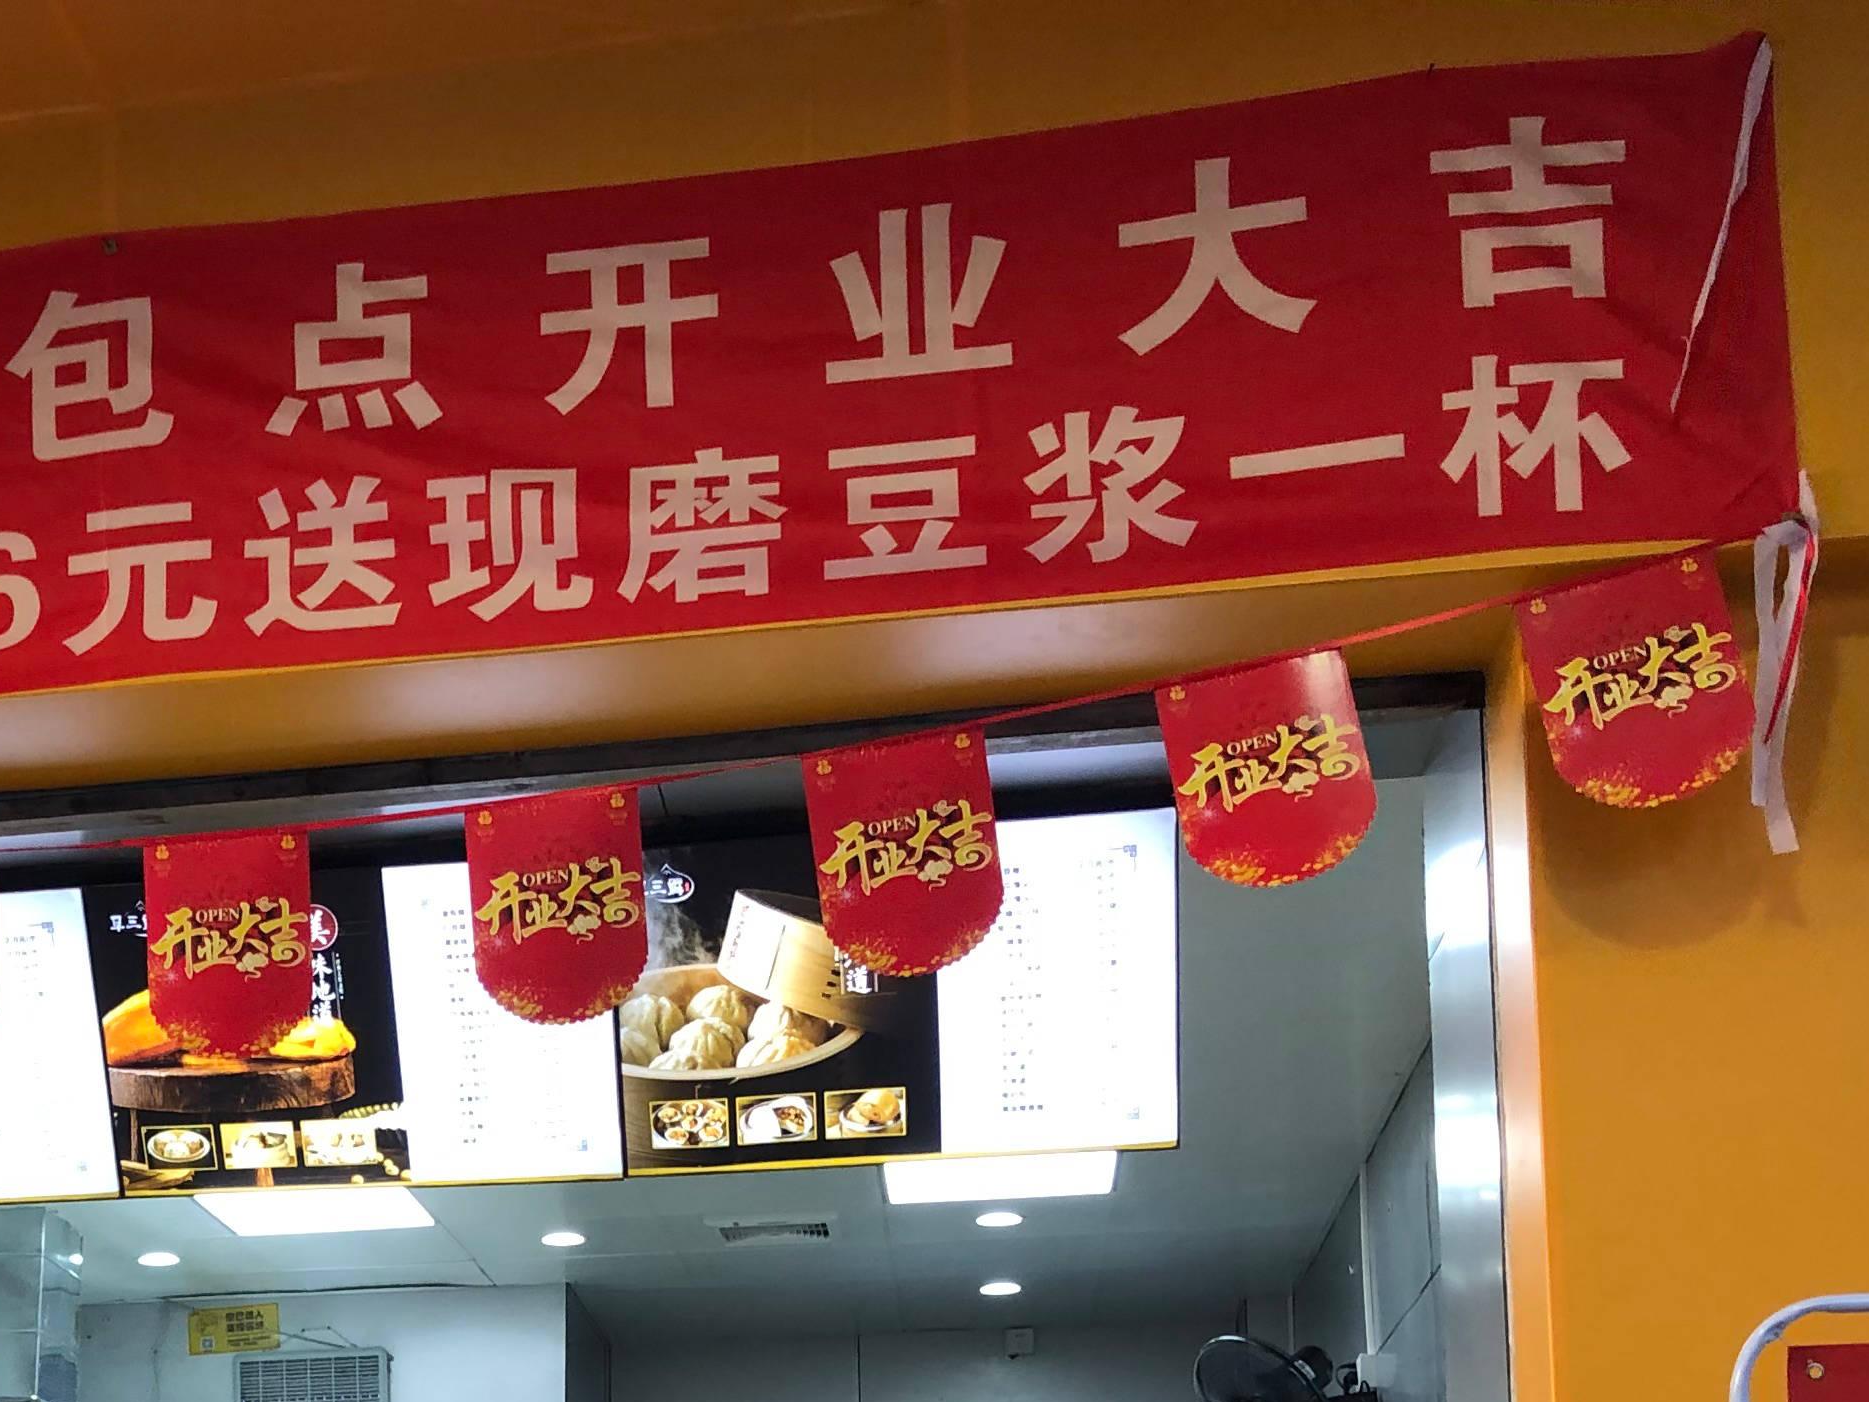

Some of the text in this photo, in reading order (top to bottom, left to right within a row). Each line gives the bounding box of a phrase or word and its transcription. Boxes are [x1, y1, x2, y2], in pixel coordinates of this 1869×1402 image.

[1544, 622, 1737, 731] 开业大吉
[1593, 645, 1648, 670] OPEN
[1178, 715, 1360, 811] 开业大吉
[1226, 732, 1278, 757] OPEN
[820, 799, 993, 896] 开业大吉
[867, 816, 917, 836] OPEN
[476, 857, 641, 943] 开业大吉
[522, 869, 570, 886] OPEN
[151, 897, 308, 979] 开业大吉
[195, 906, 240, 923] OPEN
